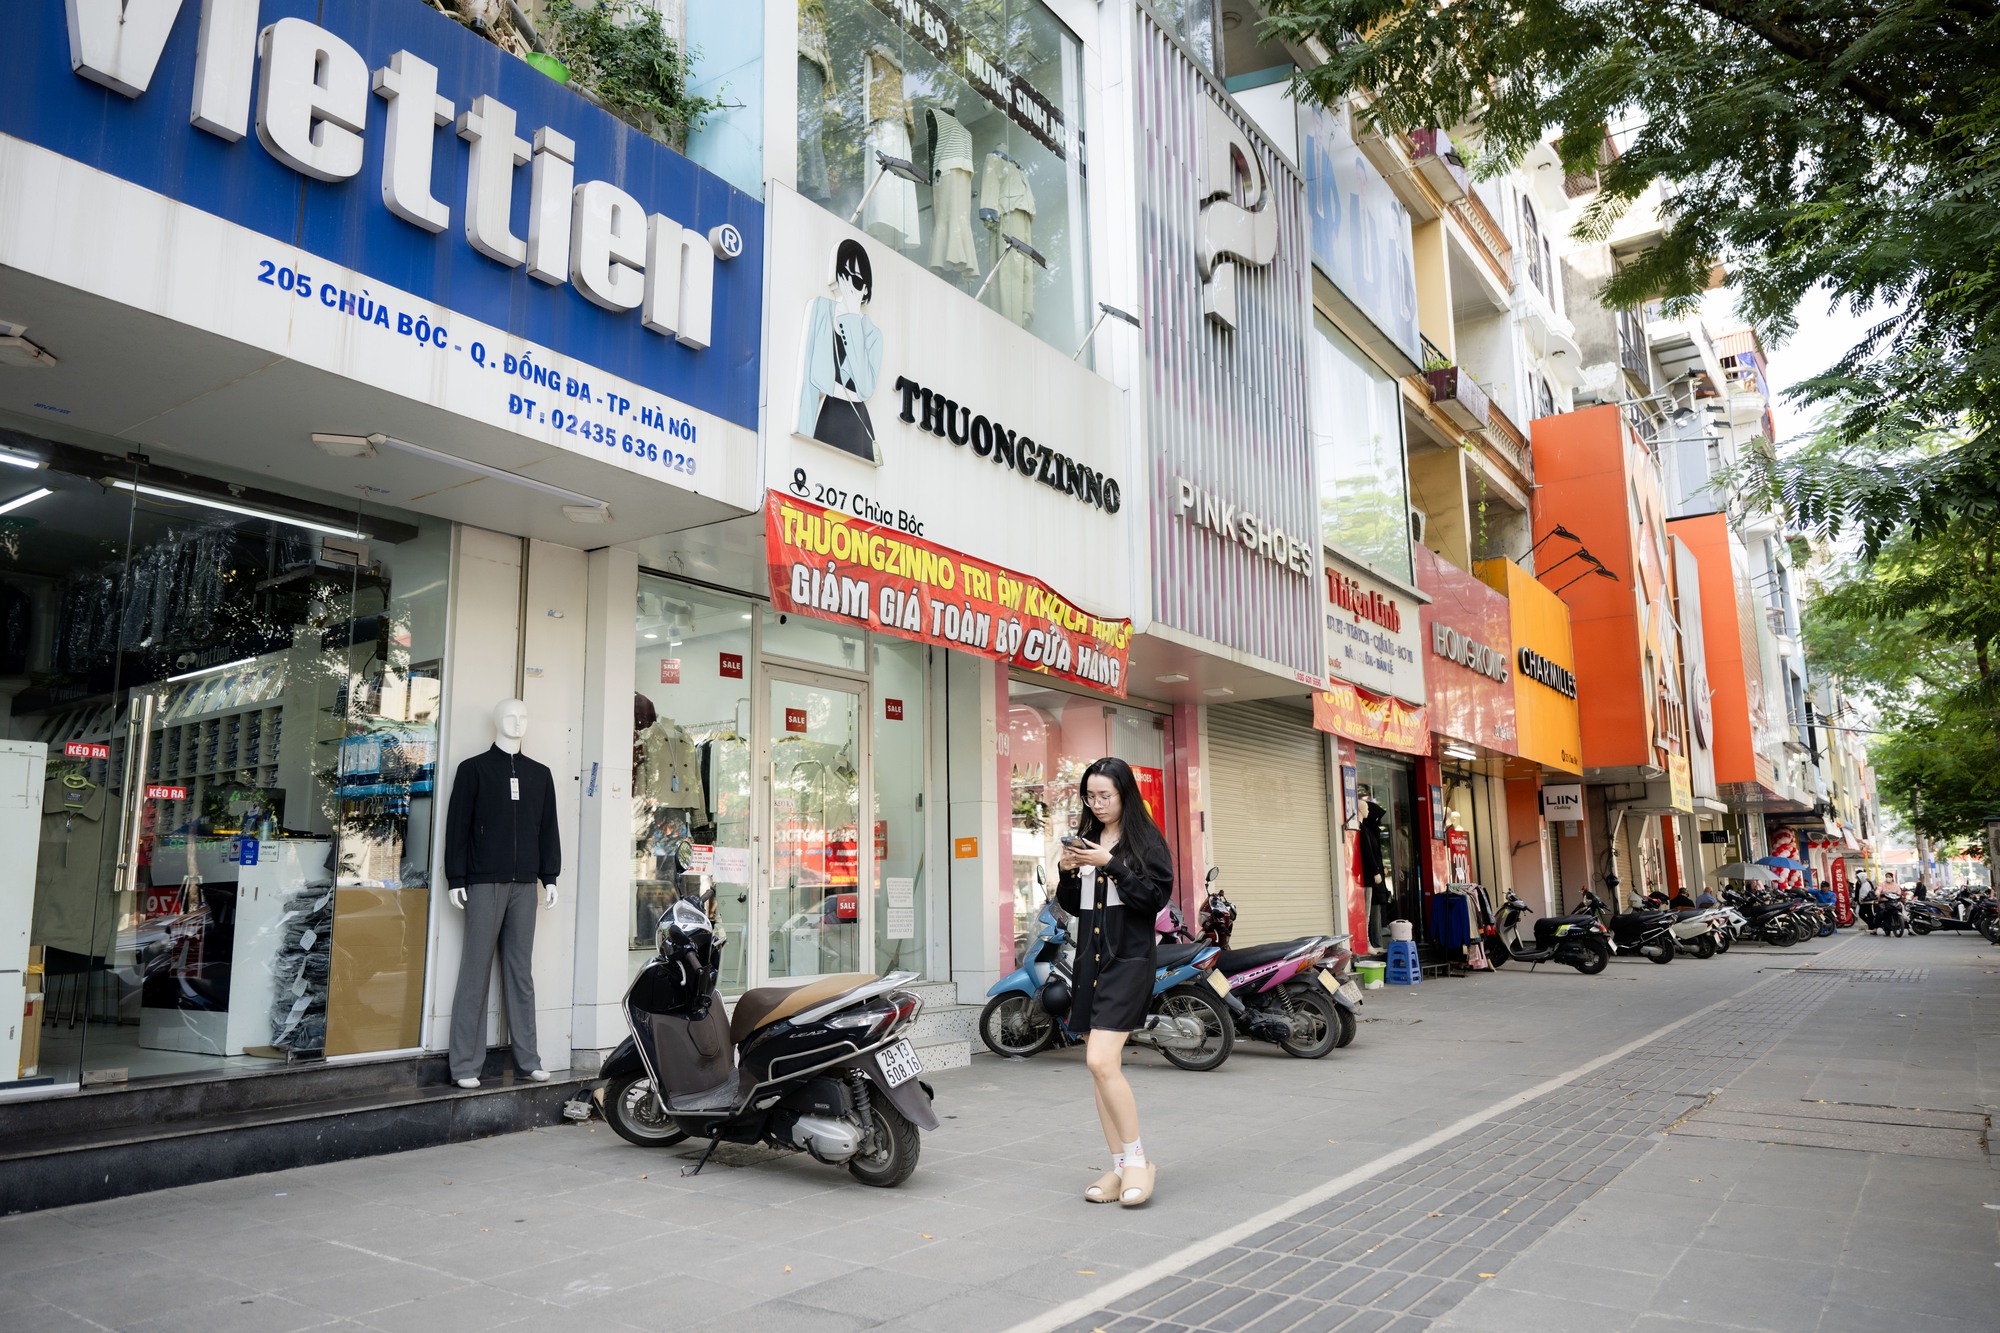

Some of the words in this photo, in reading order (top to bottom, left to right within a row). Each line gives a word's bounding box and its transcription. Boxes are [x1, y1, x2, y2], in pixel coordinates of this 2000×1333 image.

[1015, 88, 1048, 132] SINH
[258, 260, 312, 297] 205
[320, 283, 390, 329] CHÙA
[397, 312, 448, 349] BỘC
[503, 351, 561, 392] ĐỐNG
[566, 377, 591, 404] ĐA
[641, 406, 664, 432] HÀ
[551, 409, 616, 447] 02435
[622, 434, 657, 462] 636
[663, 449, 696, 476] 029
[894, 375, 1121, 515] THUONGZINNO
[815, 483, 847, 511] 207
[853, 493, 893, 527] Chùa
[1175, 475, 1237, 542] PINK
[1238, 511, 1313, 578] SHOES
[780, 504, 955, 590] THUONGZINNO
[960, 563, 992, 602] TRI
[998, 570, 1024, 611] ÂN
[1024, 583, 1088, 634] KHÁCH
[1325, 567, 1371, 623] Thiện
[1370, 590, 1401, 634] Linh
[790, 561, 869, 621] GIẢM
[879, 582, 921, 632] GIÁ
[931, 602, 990, 649] TOÀN
[996, 618, 1022, 662] BỘ
[1023, 624, 1071, 672] CỬA
[1076, 642, 1120, 688] HÀNG
[722, 660, 741, 671] SALE
[1432, 621, 1509, 684] HONGKONG
[1518, 646, 1577, 699] CHARMILLES
[788, 715, 805, 725] SALE
[887, 704, 902, 713] SALE
[68, 744, 90, 756] KÉO
[91, 748, 106, 758] RA
[149, 787, 169, 798] KÉO
[170, 790, 184, 799] RA
[1546, 795, 1578, 805] LIIN
[1835, 869, 1843, 882] 50%
[1837, 883, 1844, 892] TO
[839, 902, 855, 910] SALE
[1838, 893, 1845, 902] UP
[789, 1030, 828, 1038] LEAD
[882, 1042, 910, 1067] 29-Y3
[886, 1057, 920, 1085] 508.16
